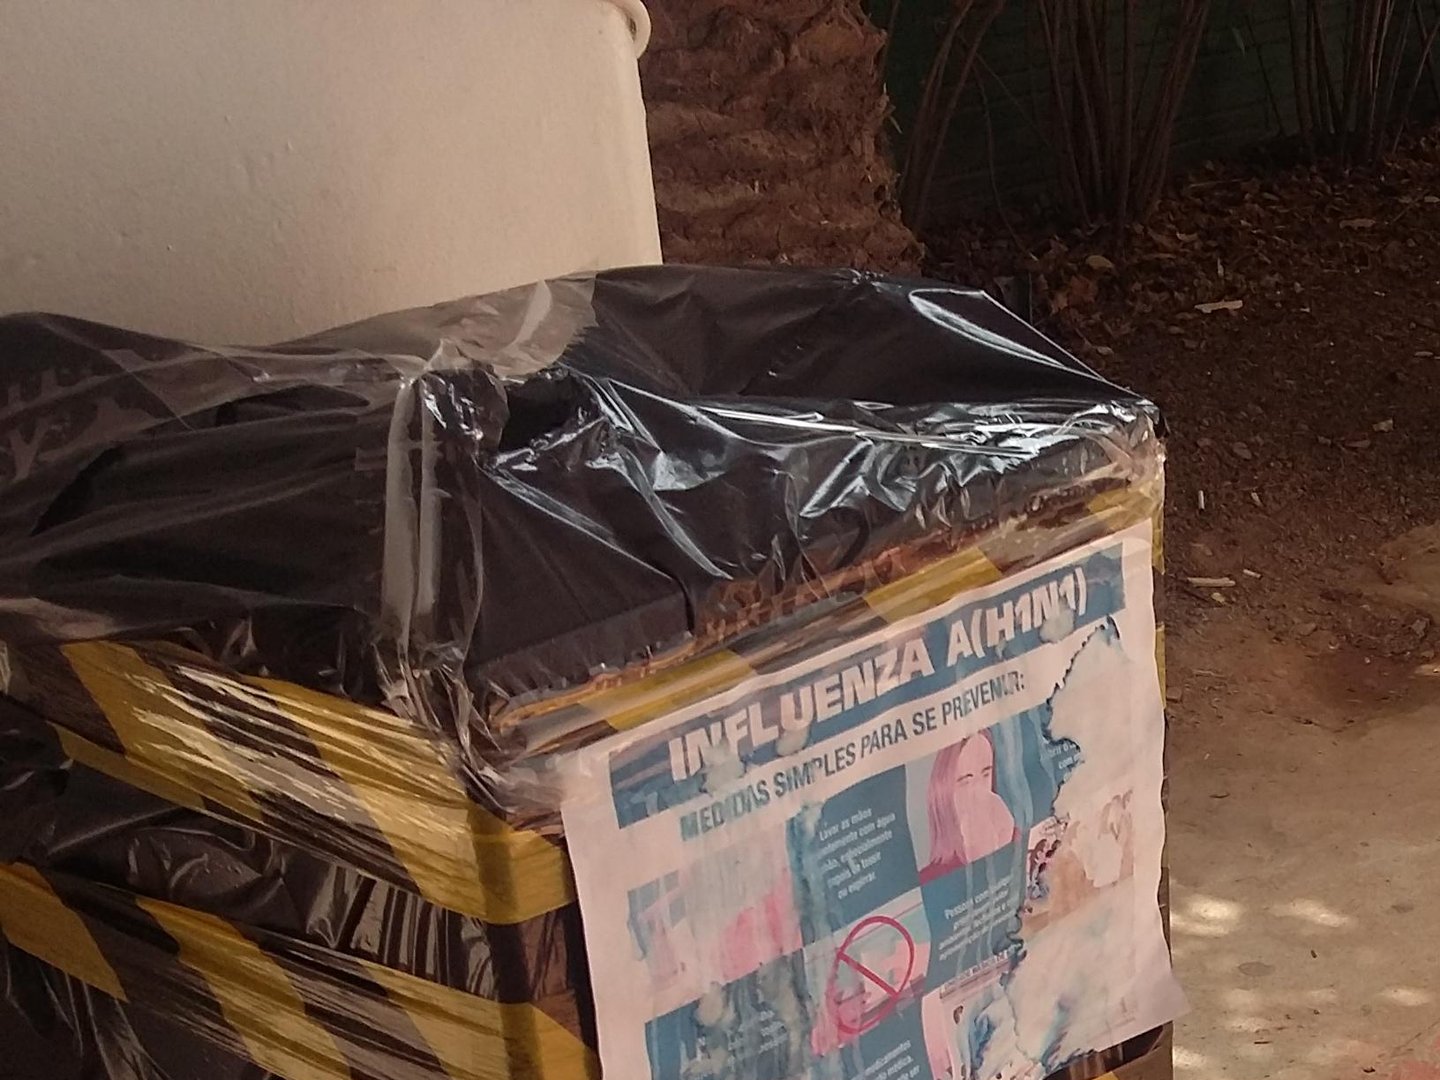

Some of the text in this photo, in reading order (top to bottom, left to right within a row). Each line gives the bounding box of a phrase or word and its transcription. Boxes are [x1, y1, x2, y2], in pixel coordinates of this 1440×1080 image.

[667, 567, 1087, 782] INFLUENZA A(H1N1)
[773, 742, 857, 799] SIMPLES
[860, 718, 908, 759] PARA
[912, 707, 937, 736] SE
